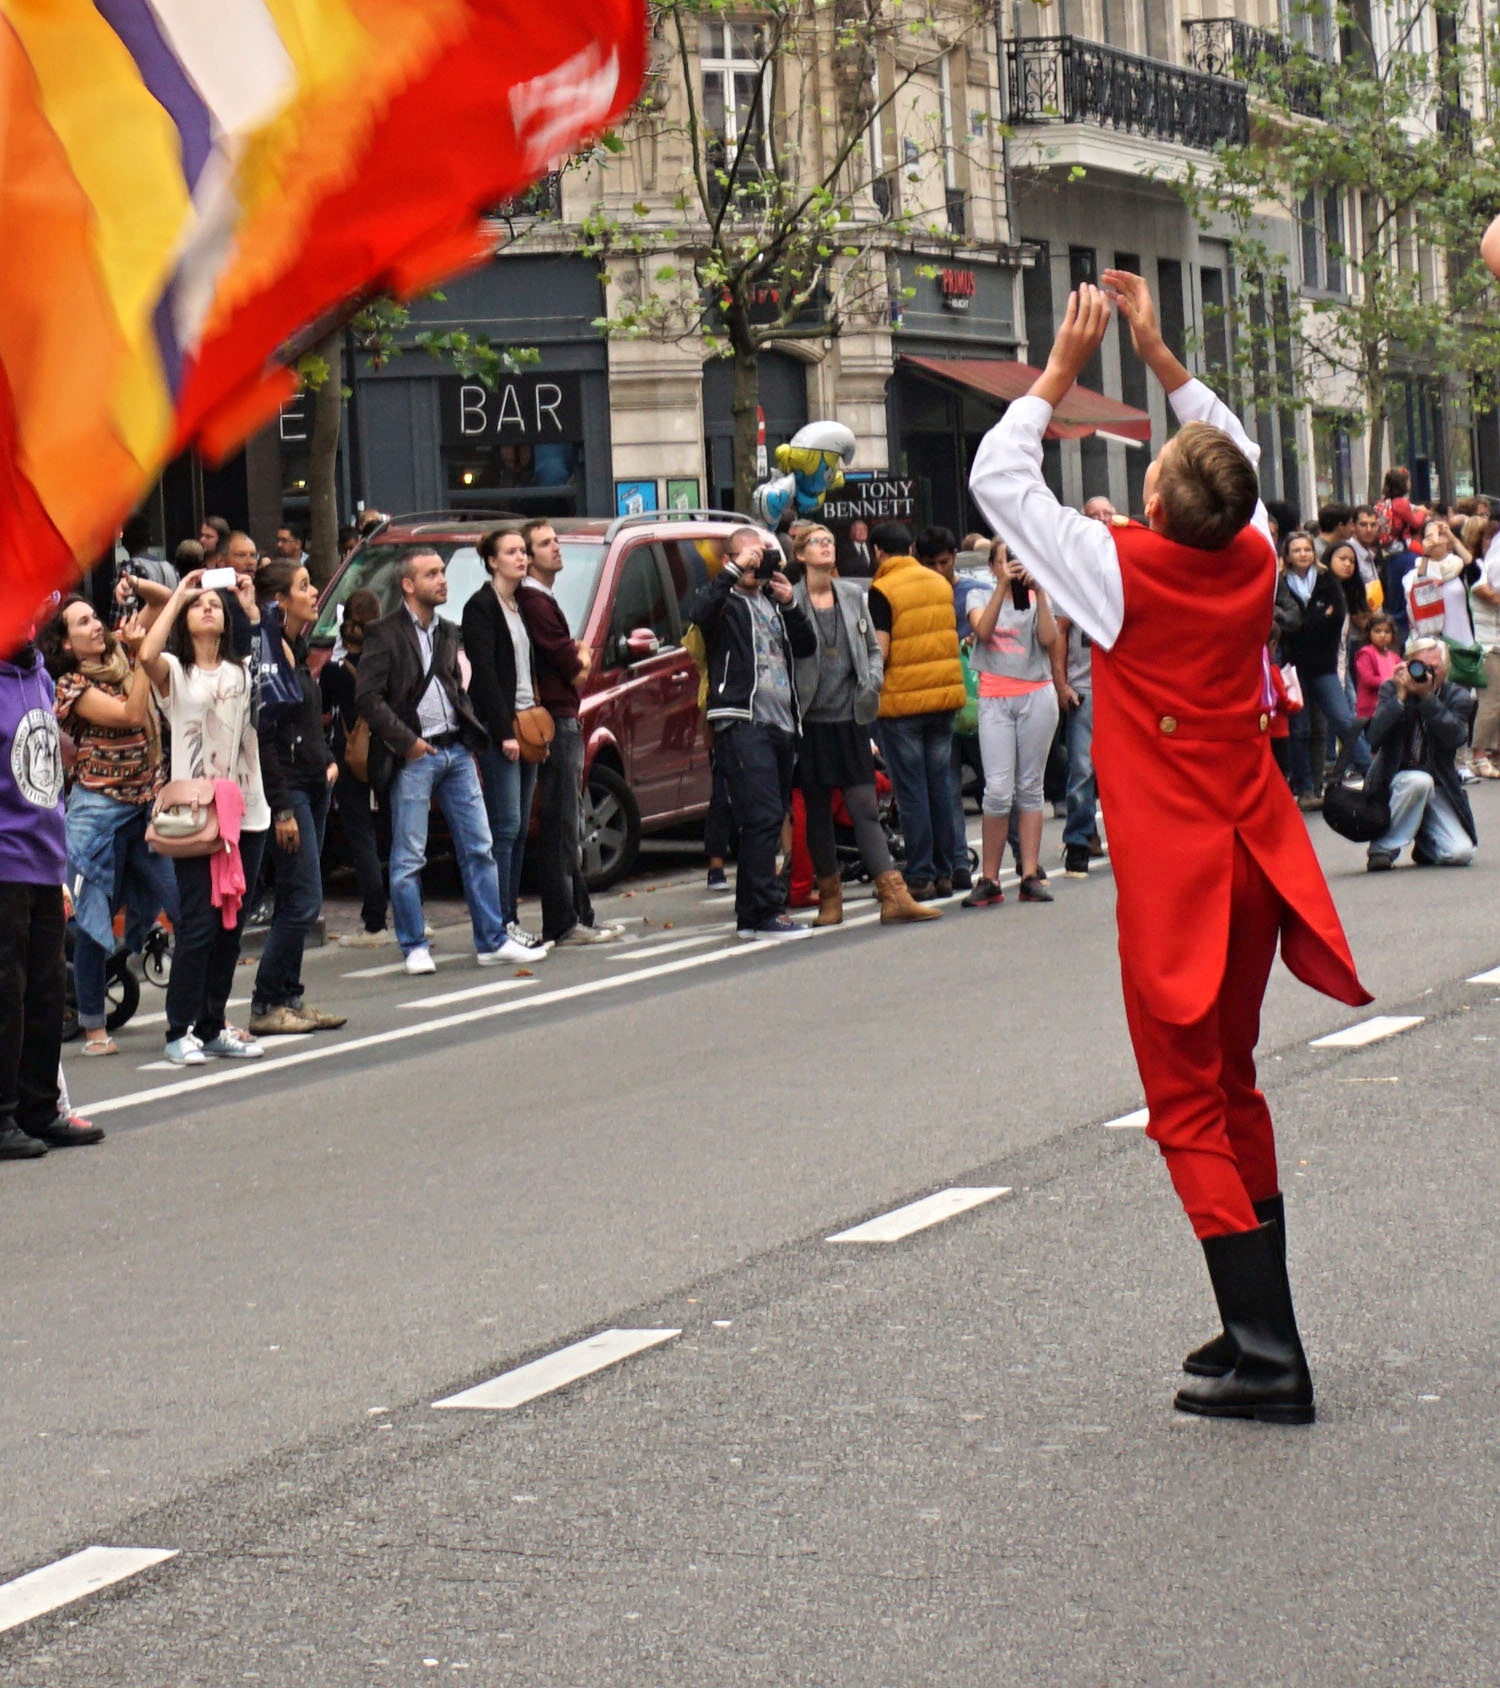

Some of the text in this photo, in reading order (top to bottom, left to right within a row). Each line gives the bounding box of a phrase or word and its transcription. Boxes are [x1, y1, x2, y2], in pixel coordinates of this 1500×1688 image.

[942, 268, 976, 296] PRIMUS
[460, 384, 563, 434] BAR
[857, 480, 914, 499] TONY
[823, 497, 915, 518] BENNETT
